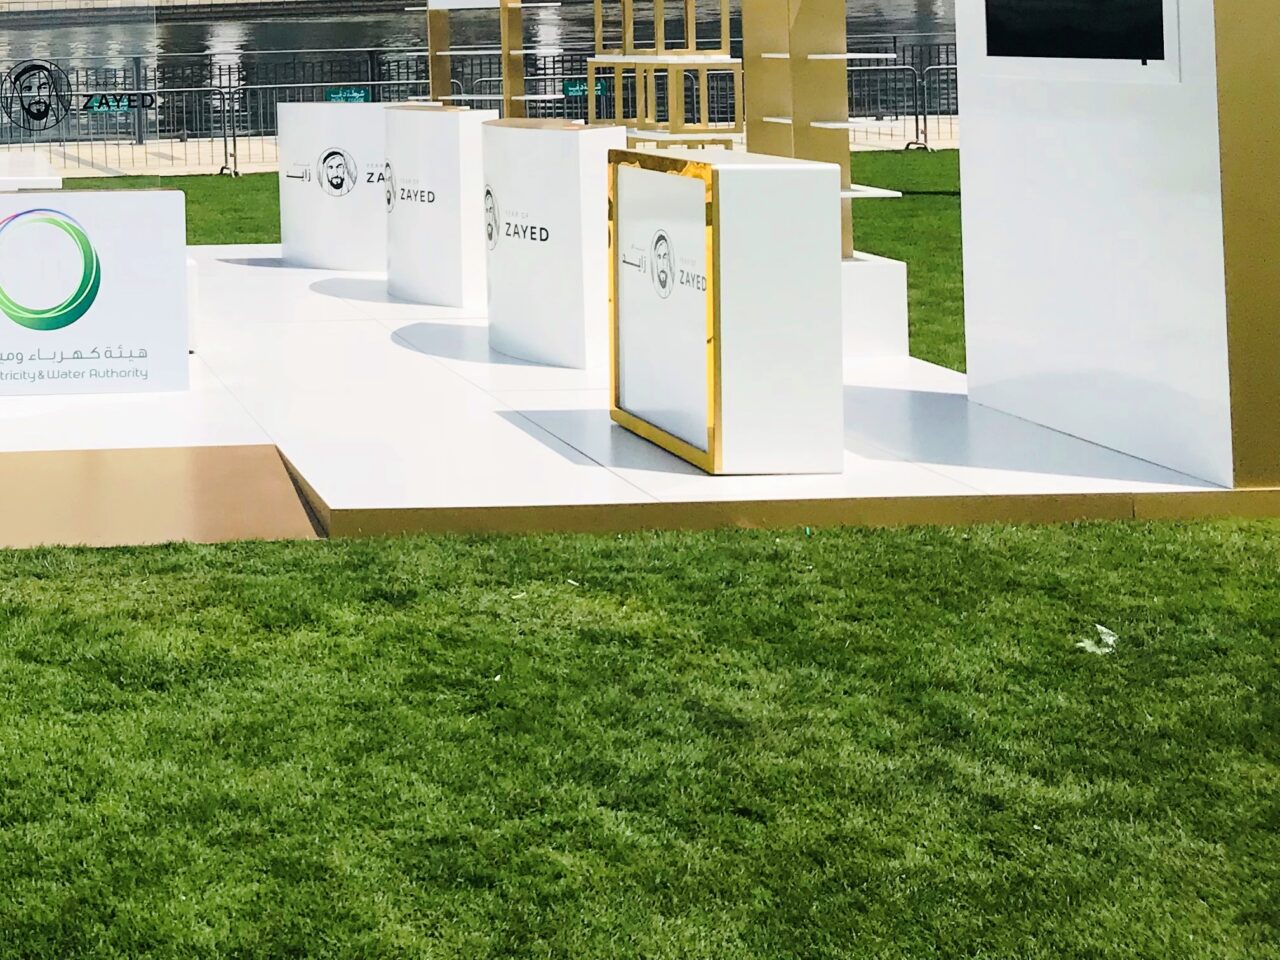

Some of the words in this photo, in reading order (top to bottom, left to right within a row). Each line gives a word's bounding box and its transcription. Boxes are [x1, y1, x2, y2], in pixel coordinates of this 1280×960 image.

[83, 93, 155, 110] ZAYED
[400, 187, 436, 203] ZAYED
[505, 221, 550, 242] ZAYED
[679, 269, 707, 292] ZAYED
[28, 346, 101, 363] كهرباء
[104, 344, 148, 362] هيئة
[47, 369, 86, 380] Water
[89, 367, 149, 380] Authority
